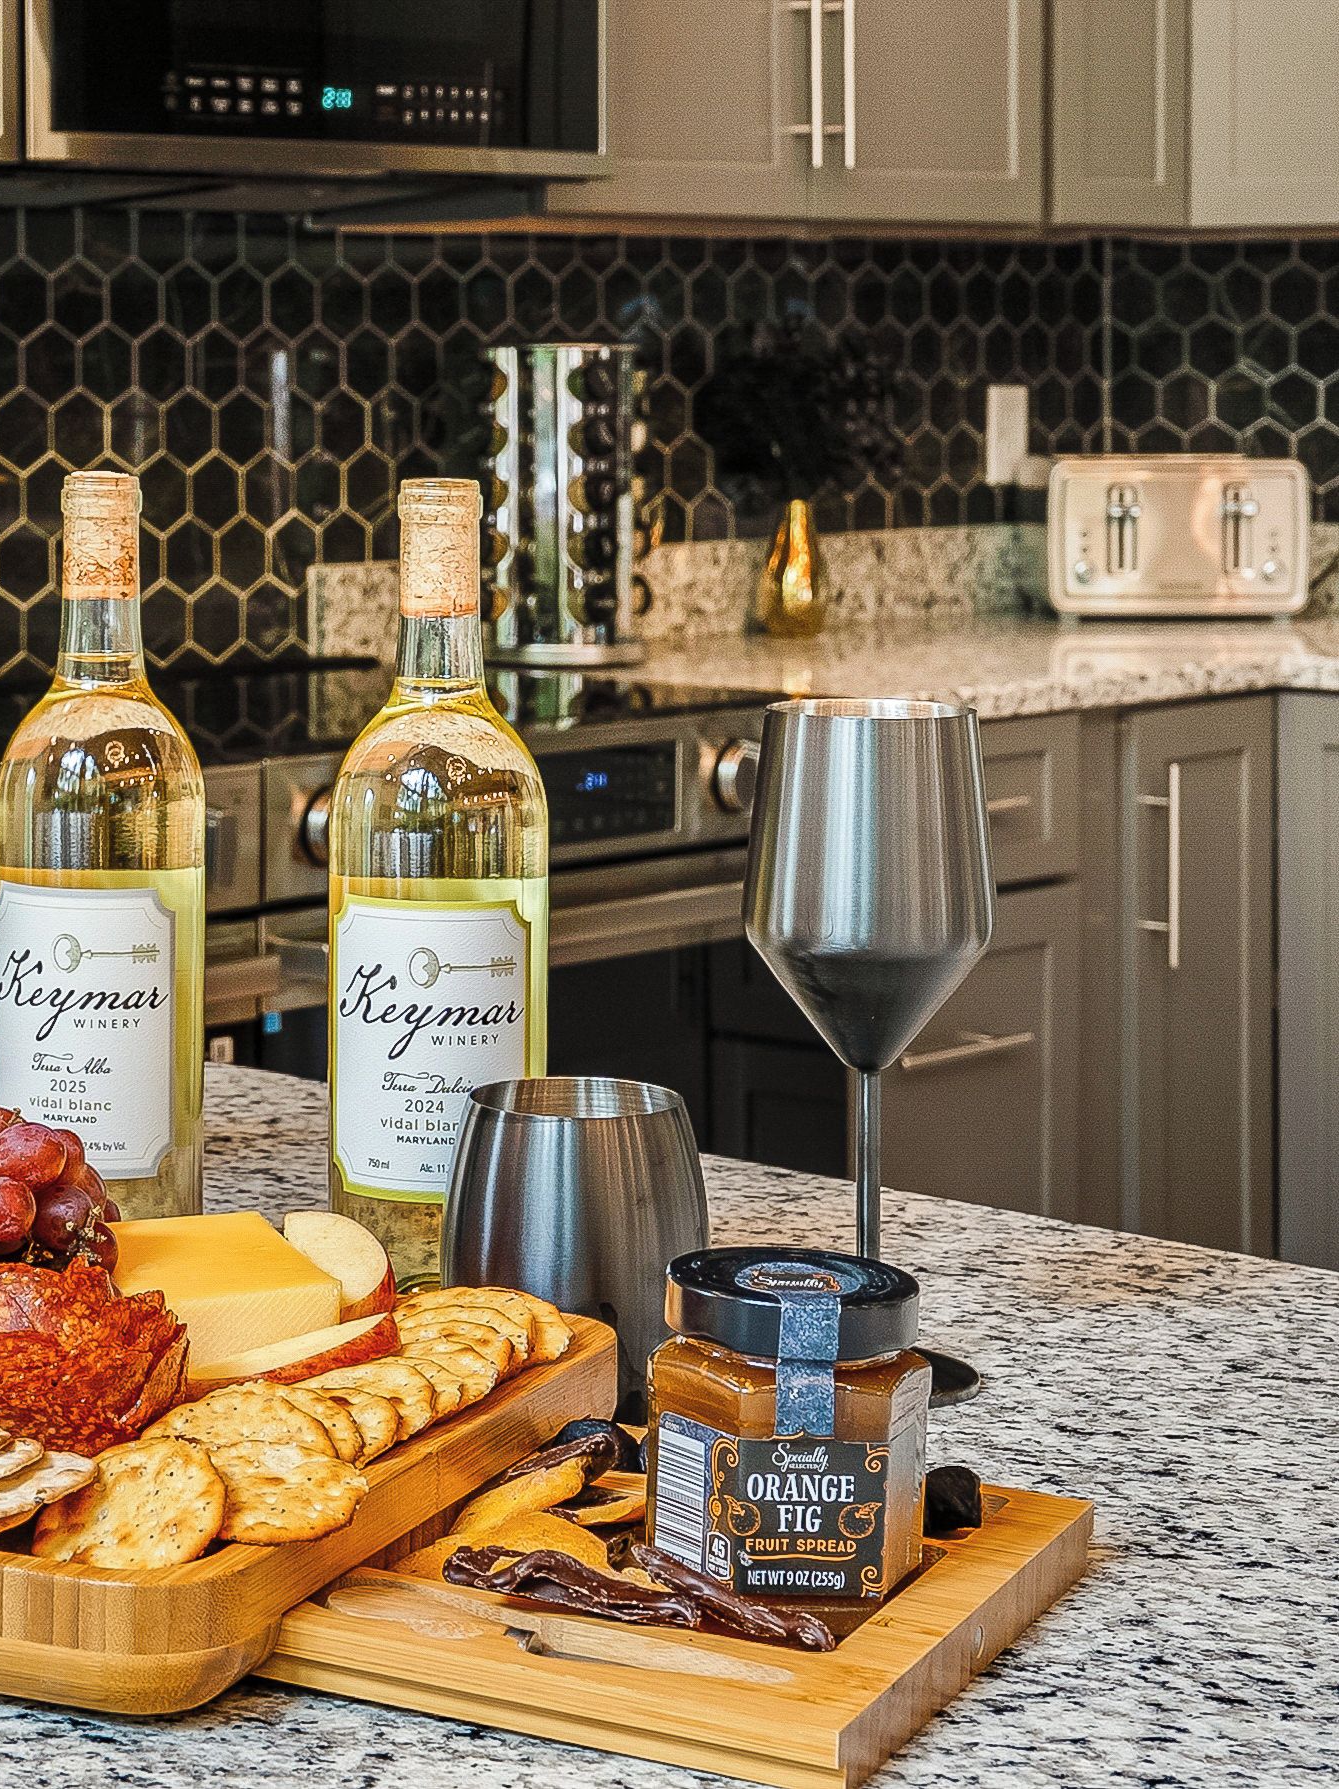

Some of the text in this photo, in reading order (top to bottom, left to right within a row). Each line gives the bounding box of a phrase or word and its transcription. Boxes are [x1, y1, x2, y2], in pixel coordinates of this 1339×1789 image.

[340, 964, 524, 1060] Keymar
[73, 1018, 141, 1029] WINERY
[431, 1034, 499, 1046] WINERY
[66, 1057, 113, 1075] Alba
[50, 1078, 87, 1094] 2025
[29, 1096, 112, 1111] vidal blanc
[404, 1099, 445, 1114] 2024
[43, 1114, 98, 1124] MARYLAND
[380, 1116, 418, 1130] vidal
[396, 1135, 456, 1145] MARYLAND
[772, 1442, 829, 1472] Specially
[746, 1472, 855, 1502] ORANGE
[776, 1504, 822, 1533] FIG
[712, 1537, 726, 1558] 45
[745, 1538, 857, 1552] FRUIT SPREAD
[747, 1570, 846, 1590] NET WT 9 OZ (255g)
